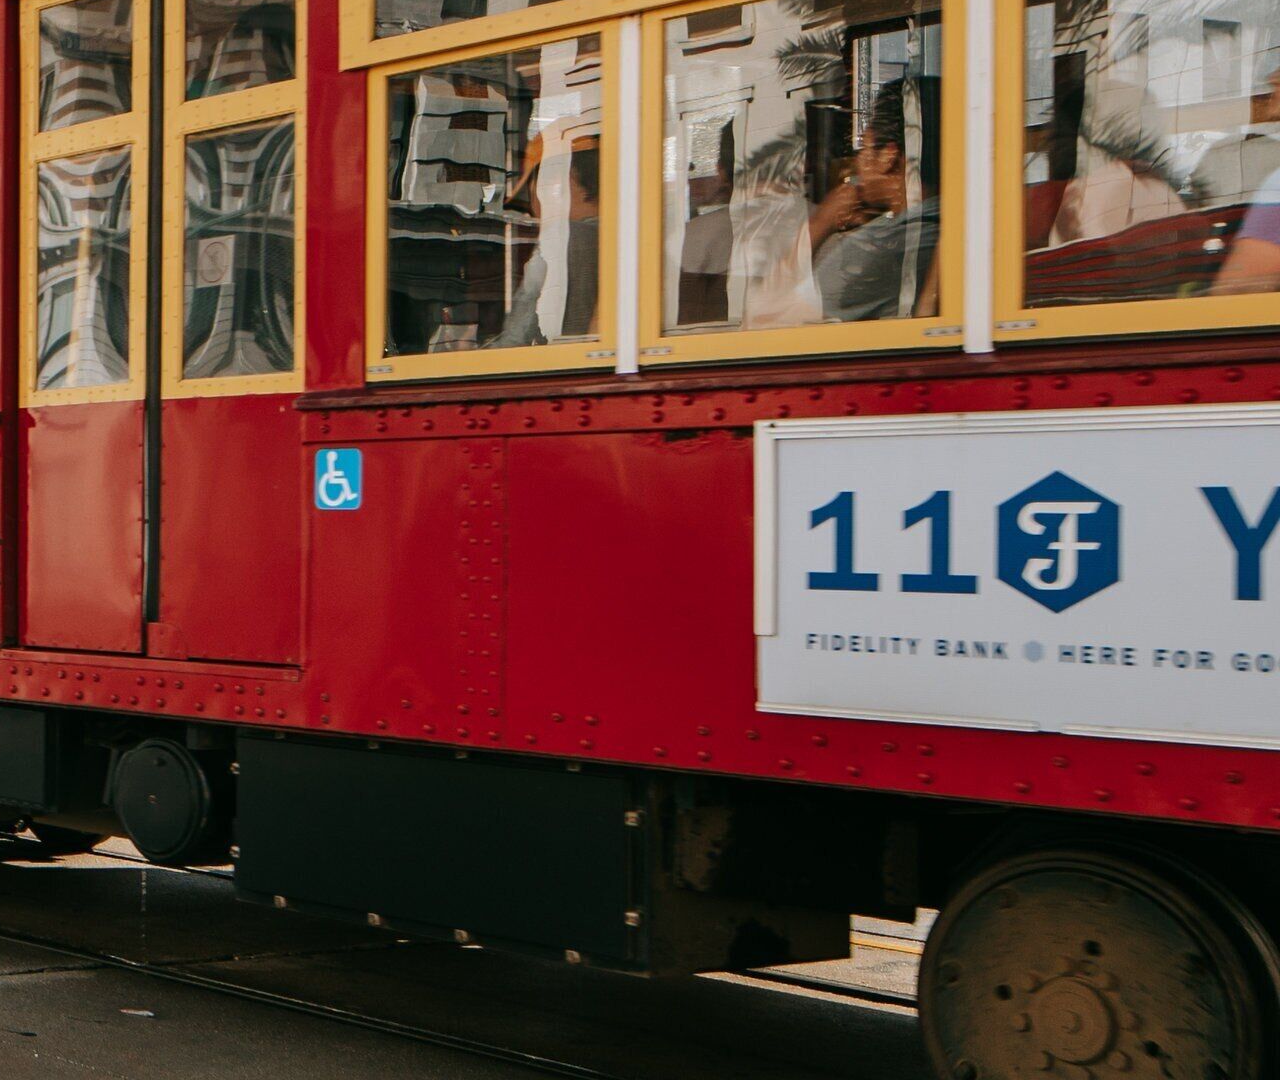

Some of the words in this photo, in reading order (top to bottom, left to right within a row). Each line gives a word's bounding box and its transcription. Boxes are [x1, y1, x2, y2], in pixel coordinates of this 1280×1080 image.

[806, 633, 922, 655] FIDELITY
[935, 639, 1009, 659] BANK
[1058, 645, 1138, 666] HERE
[1153, 649, 1215, 670] FOR
[1231, 653, 1280, 673] GO
